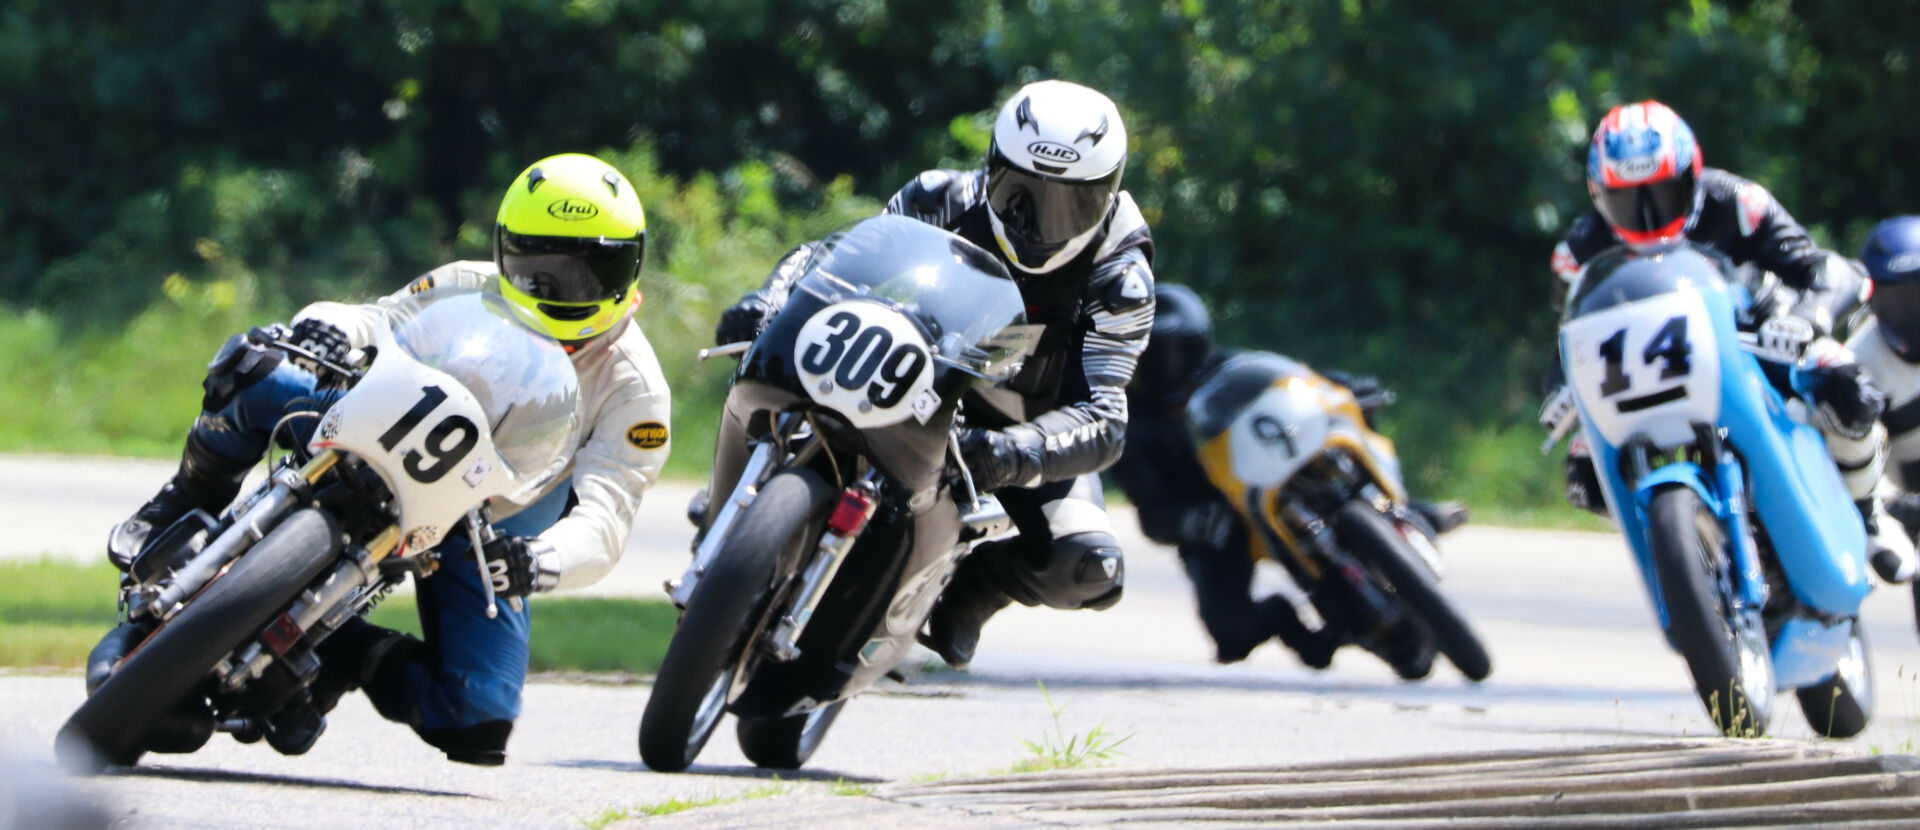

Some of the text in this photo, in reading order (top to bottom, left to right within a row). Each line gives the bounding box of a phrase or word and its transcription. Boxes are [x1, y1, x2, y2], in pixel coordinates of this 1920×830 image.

[1034, 144, 1074, 160] HJC
[553, 200, 592, 214] Arai
[801, 311, 926, 409] 309
[1599, 315, 1692, 398] 14
[377, 385, 479, 484] 19
[1252, 415, 1297, 459] 9
